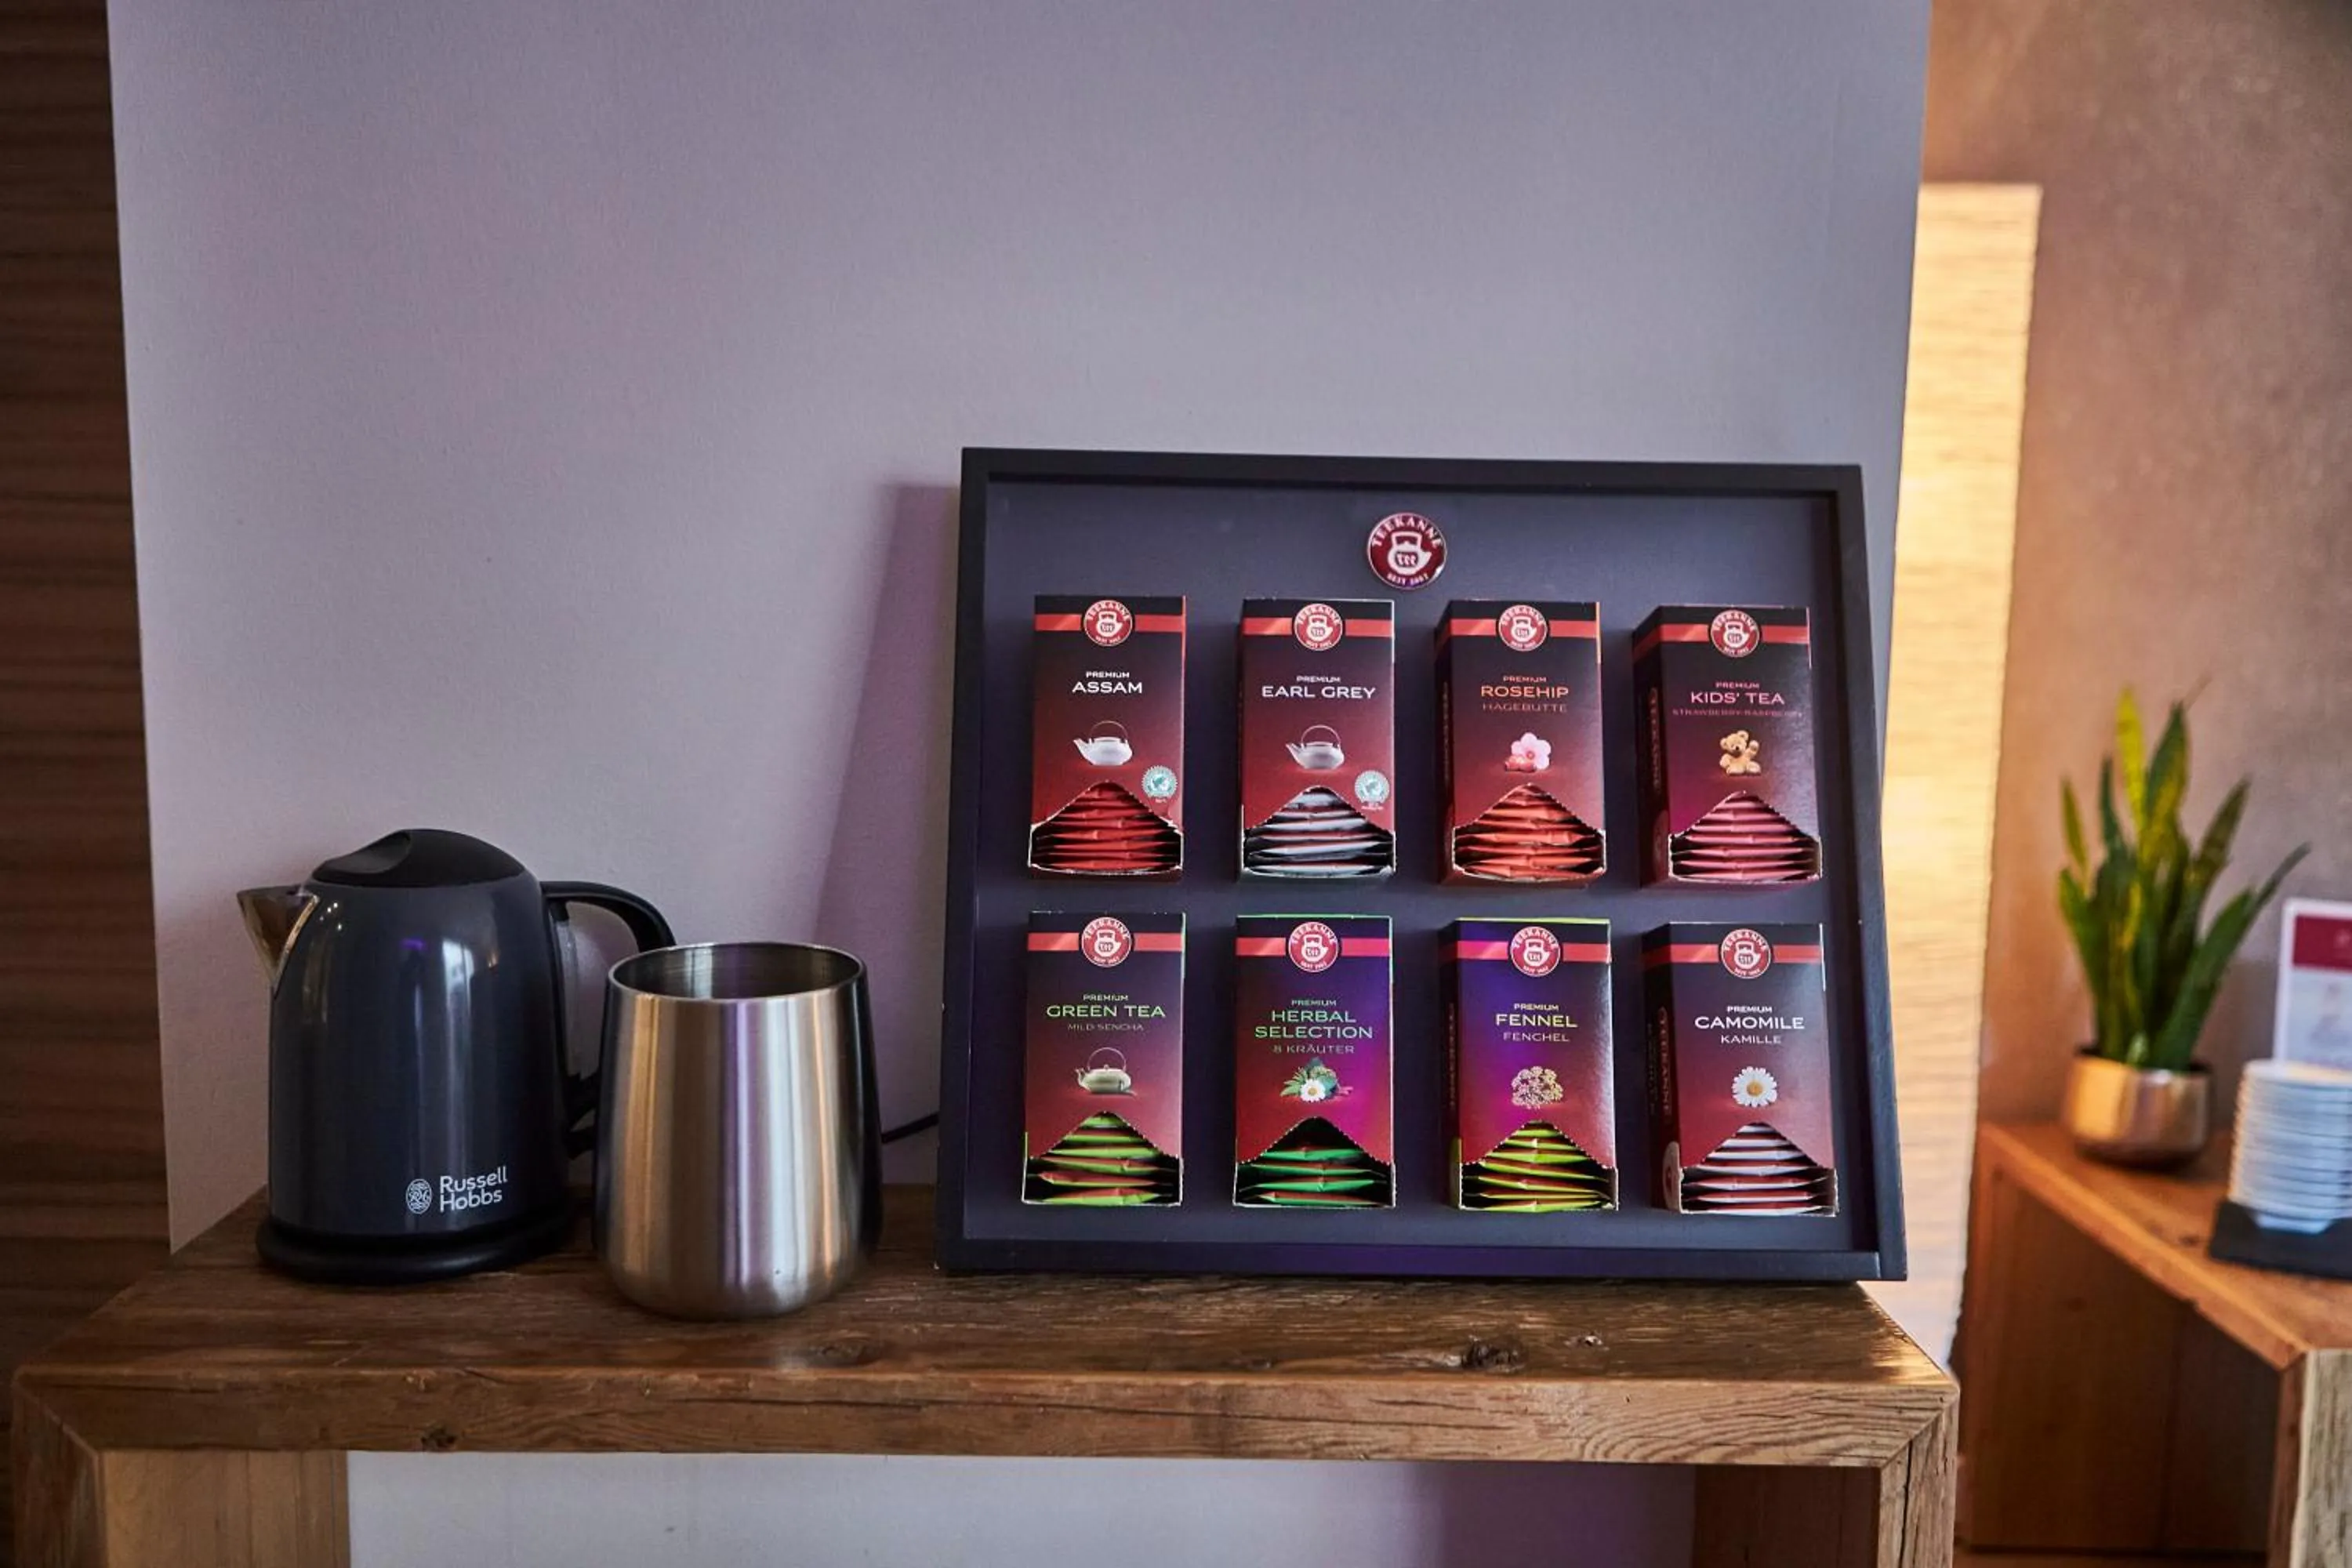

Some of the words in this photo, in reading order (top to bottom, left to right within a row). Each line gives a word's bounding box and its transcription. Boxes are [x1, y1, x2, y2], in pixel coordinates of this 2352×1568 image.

[1373, 516, 1443, 549] TEEKANNE
[1072, 681, 1142, 694] ASSAM
[1261, 686, 1316, 698] EARL
[1321, 687, 1376, 699] GREY
[1480, 685, 1569, 699] ROSEHIP
[1690, 691, 1740, 704] KIDS'
[1746, 692, 1785, 705] TEA
[1483, 702, 1567, 713] HAGEBUTTE
[1047, 1005, 1117, 1018] GREEN
[1123, 1006, 1166, 1018] TEA
[1272, 1011, 1357, 1023] HERBAL
[1496, 1014, 1577, 1028] FENNEL
[1694, 1016, 1805, 1029] CAMOMILE
[1254, 1026, 1373, 1038] SELECTION
[1503, 1032, 1570, 1042] FENCHEL
[1721, 1035, 1781, 1044] KAMILLE
[1287, 1044, 1355, 1054] KRÄUTER
[440, 1166, 508, 1194] Russell
[440, 1189, 503, 1213] Hobbs
